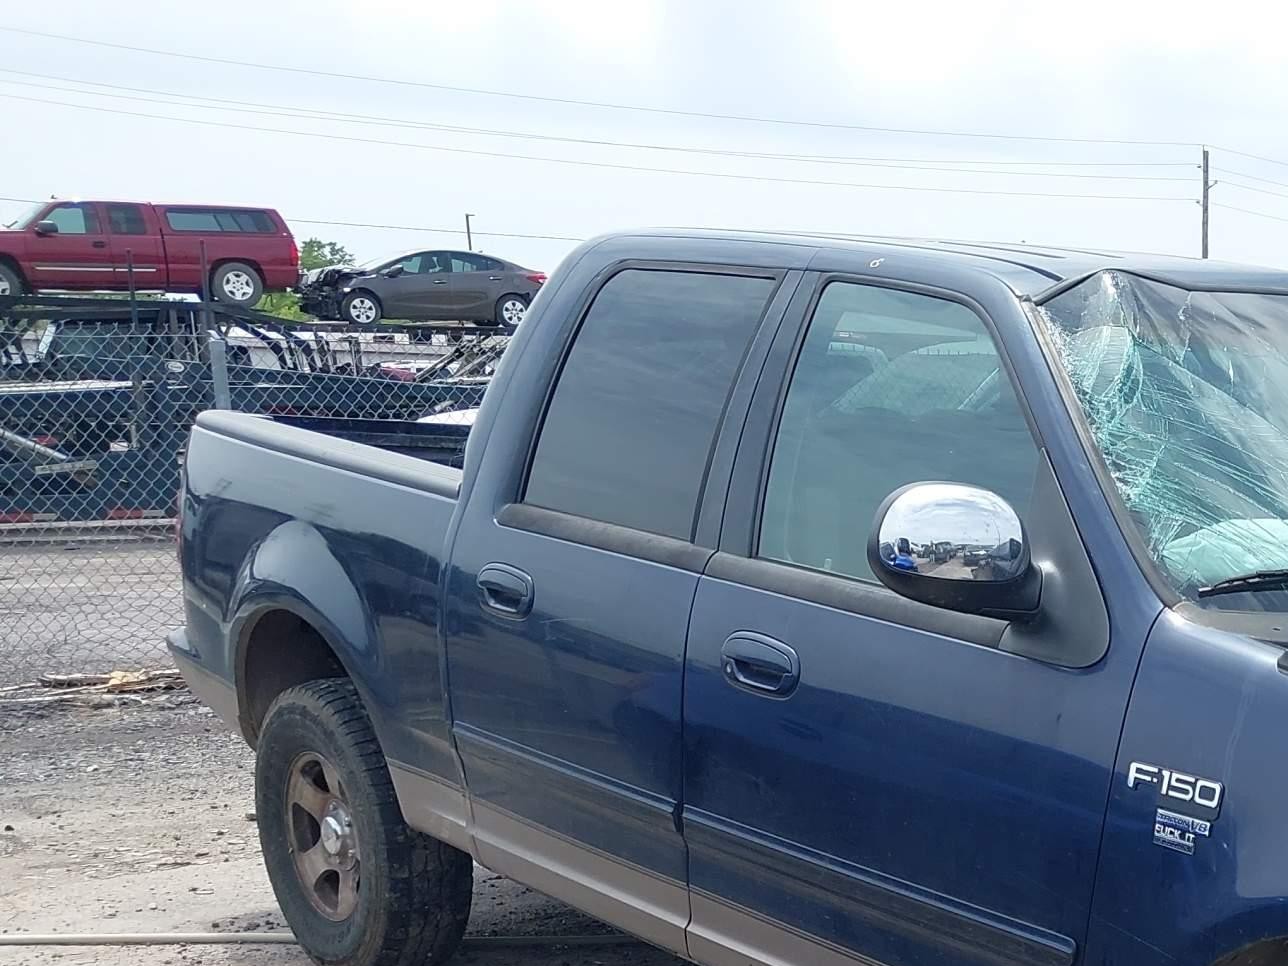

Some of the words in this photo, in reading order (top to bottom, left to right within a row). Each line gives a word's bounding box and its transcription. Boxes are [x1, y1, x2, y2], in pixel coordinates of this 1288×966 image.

[1154, 823, 1181, 841] SUCK
[1185, 832, 1196, 844] IT
[1190, 819, 1209, 833] V8
